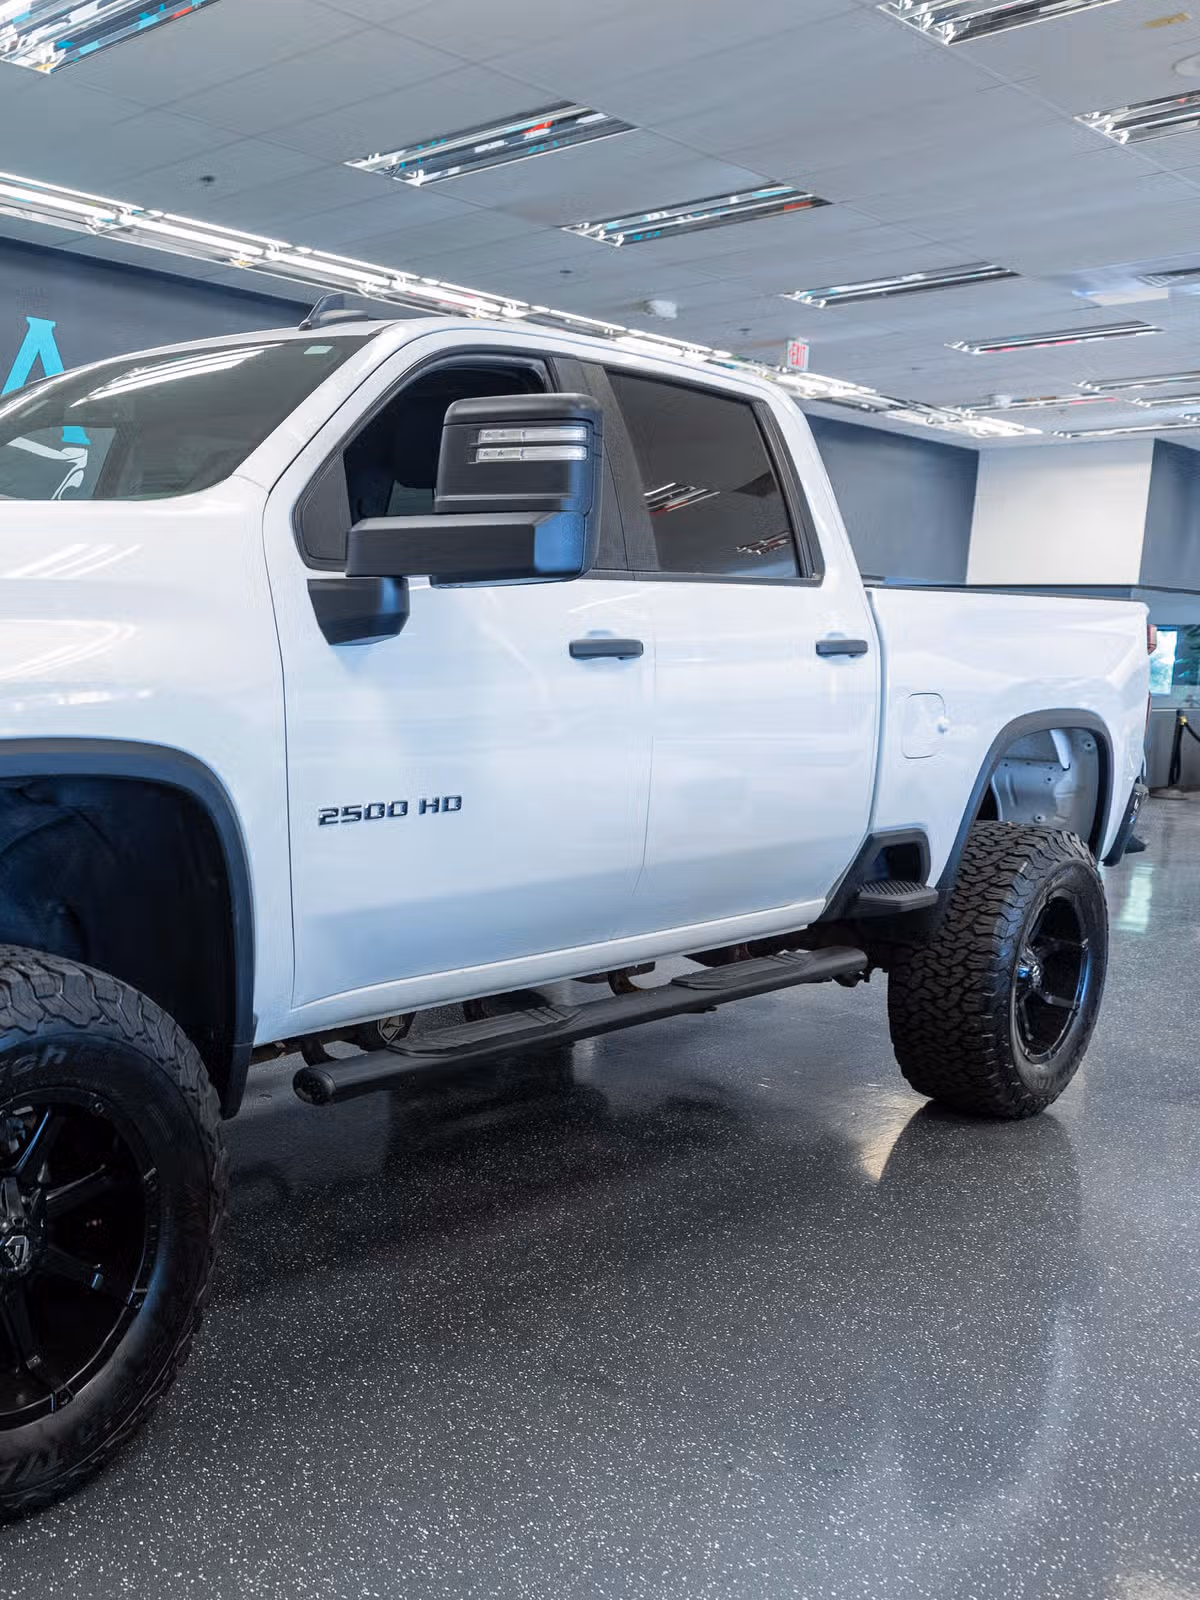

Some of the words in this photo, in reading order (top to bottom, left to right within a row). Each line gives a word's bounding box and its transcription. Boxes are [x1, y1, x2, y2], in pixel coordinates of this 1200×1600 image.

[791, 342, 807, 369] EXIT
[318, 801, 408, 826] 2500
[418, 795, 463, 815] HD
